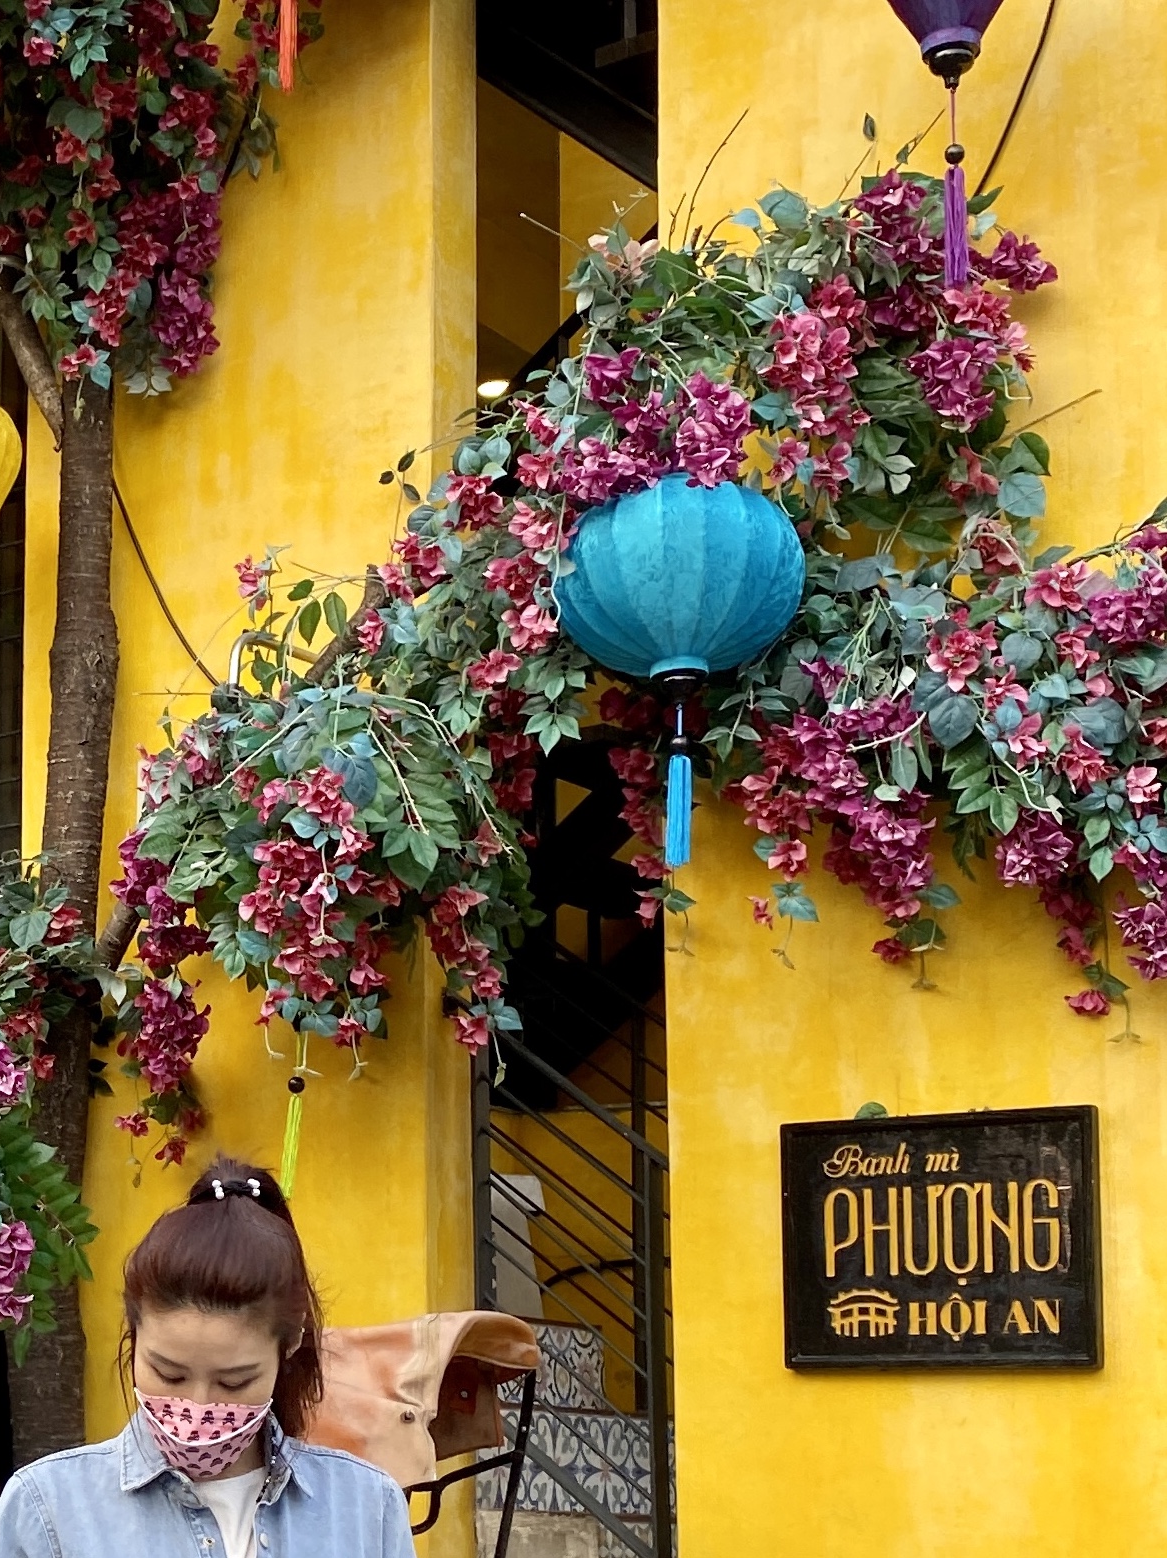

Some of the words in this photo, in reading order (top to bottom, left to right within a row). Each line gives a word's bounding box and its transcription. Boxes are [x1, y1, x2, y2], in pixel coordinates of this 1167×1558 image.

[925, 1146, 960, 1173] mì
[823, 1178, 1061, 1286] PHƯỢNG
[908, 1293, 988, 1342] HỘI
[1003, 1299, 1061, 1335] AN
